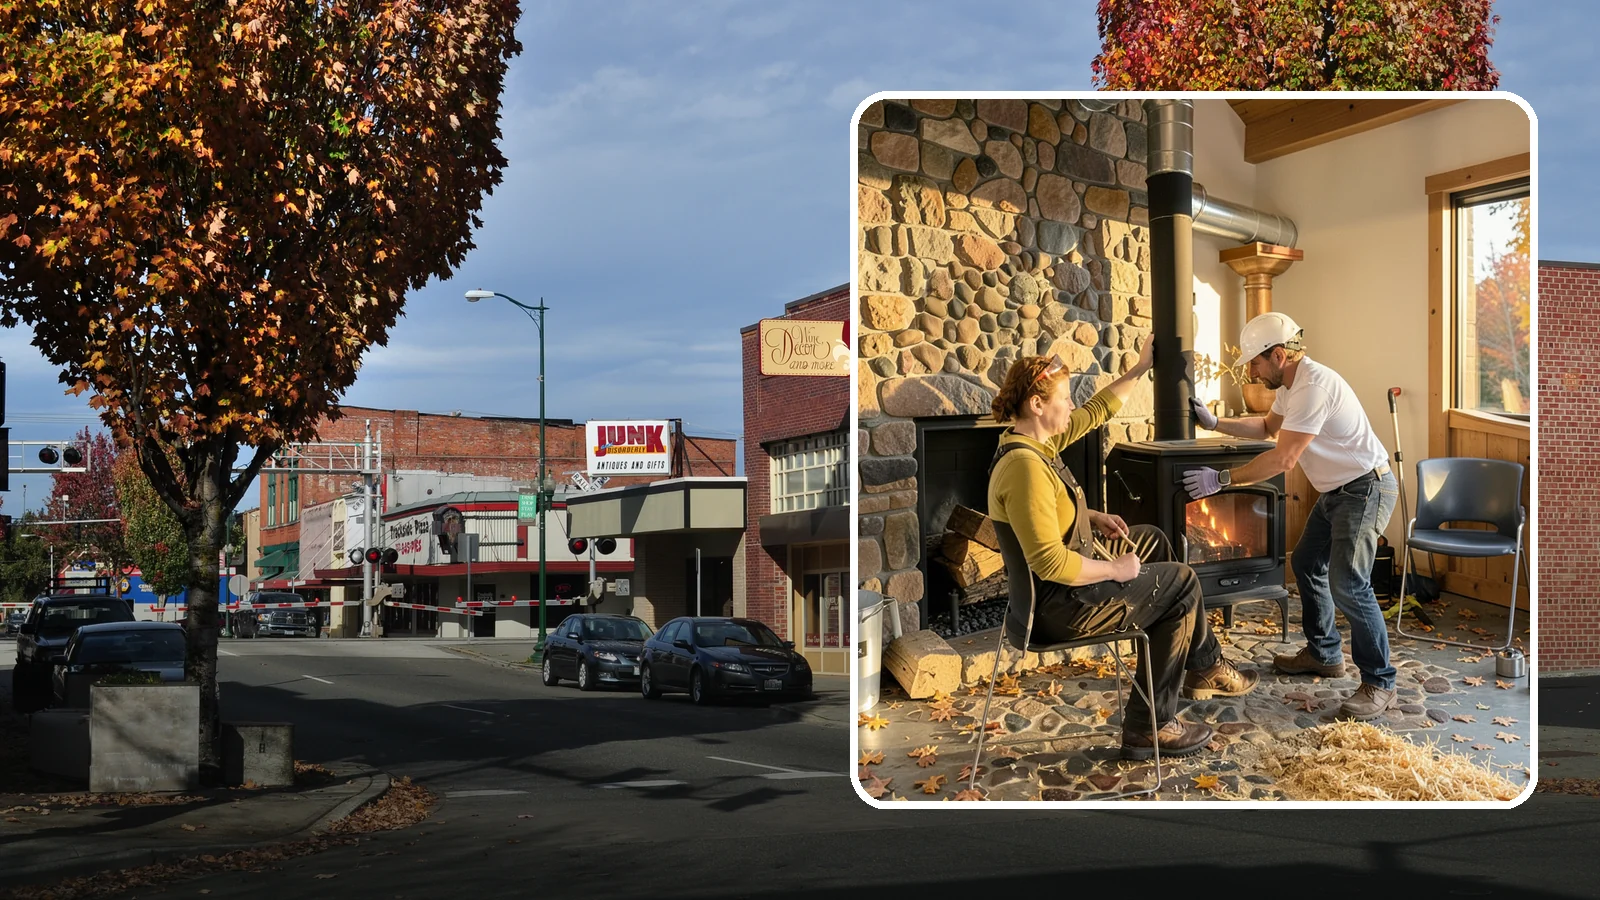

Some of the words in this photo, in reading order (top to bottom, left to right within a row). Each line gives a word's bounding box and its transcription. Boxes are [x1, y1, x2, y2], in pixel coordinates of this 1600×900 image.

[595, 425, 665, 457] JUNK
[607, 446, 646, 454] DISORDERLY
[597, 461, 628, 470] ANTIQUES
[631, 461, 644, 470] AND
[647, 460, 665, 470] GIFTS
[390, 521, 412, 539] Trackside
[414, 519, 429, 535] Pizza
